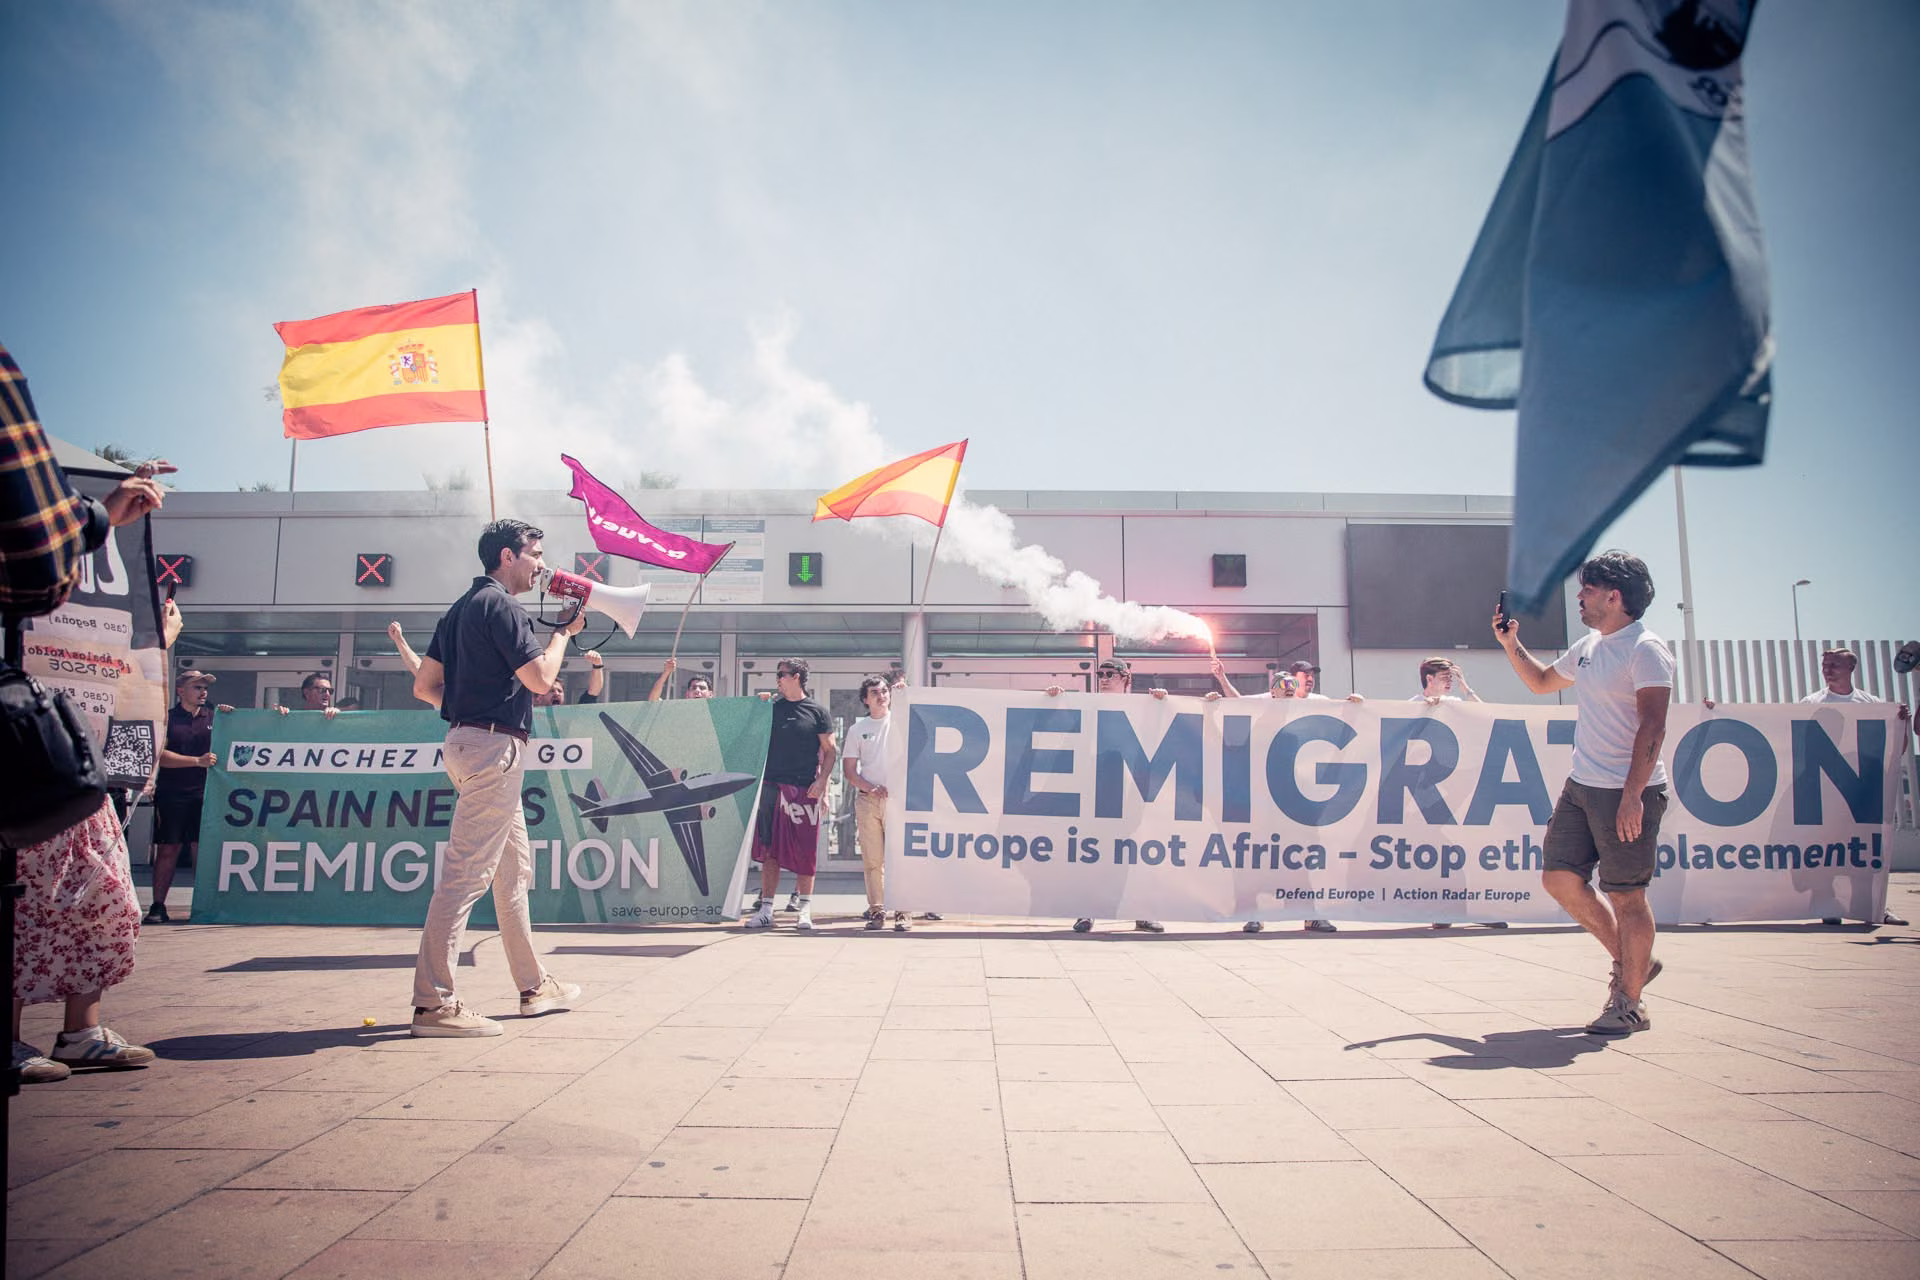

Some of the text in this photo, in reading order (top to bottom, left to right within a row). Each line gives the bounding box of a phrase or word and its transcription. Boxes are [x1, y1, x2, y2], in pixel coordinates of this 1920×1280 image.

[255, 747, 418, 768] SANCHEZ
[537, 744, 583, 764] GO
[904, 703, 1887, 828] REMIGRAON
[224, 786, 547, 828] SPAIN NES
[904, 822, 1054, 869] Europe
[1068, 826, 1100, 864] is
[1114, 833, 1186, 867] not
[1200, 832, 1327, 870] Africa
[1369, 834, 1466, 878] Stop
[1275, 887, 1324, 900] Defend
[1328, 888, 1375, 901] Europe
[1393, 887, 1438, 901] Action
[1442, 888, 1481, 901] Radar
[1484, 889, 1531, 902] Europe
